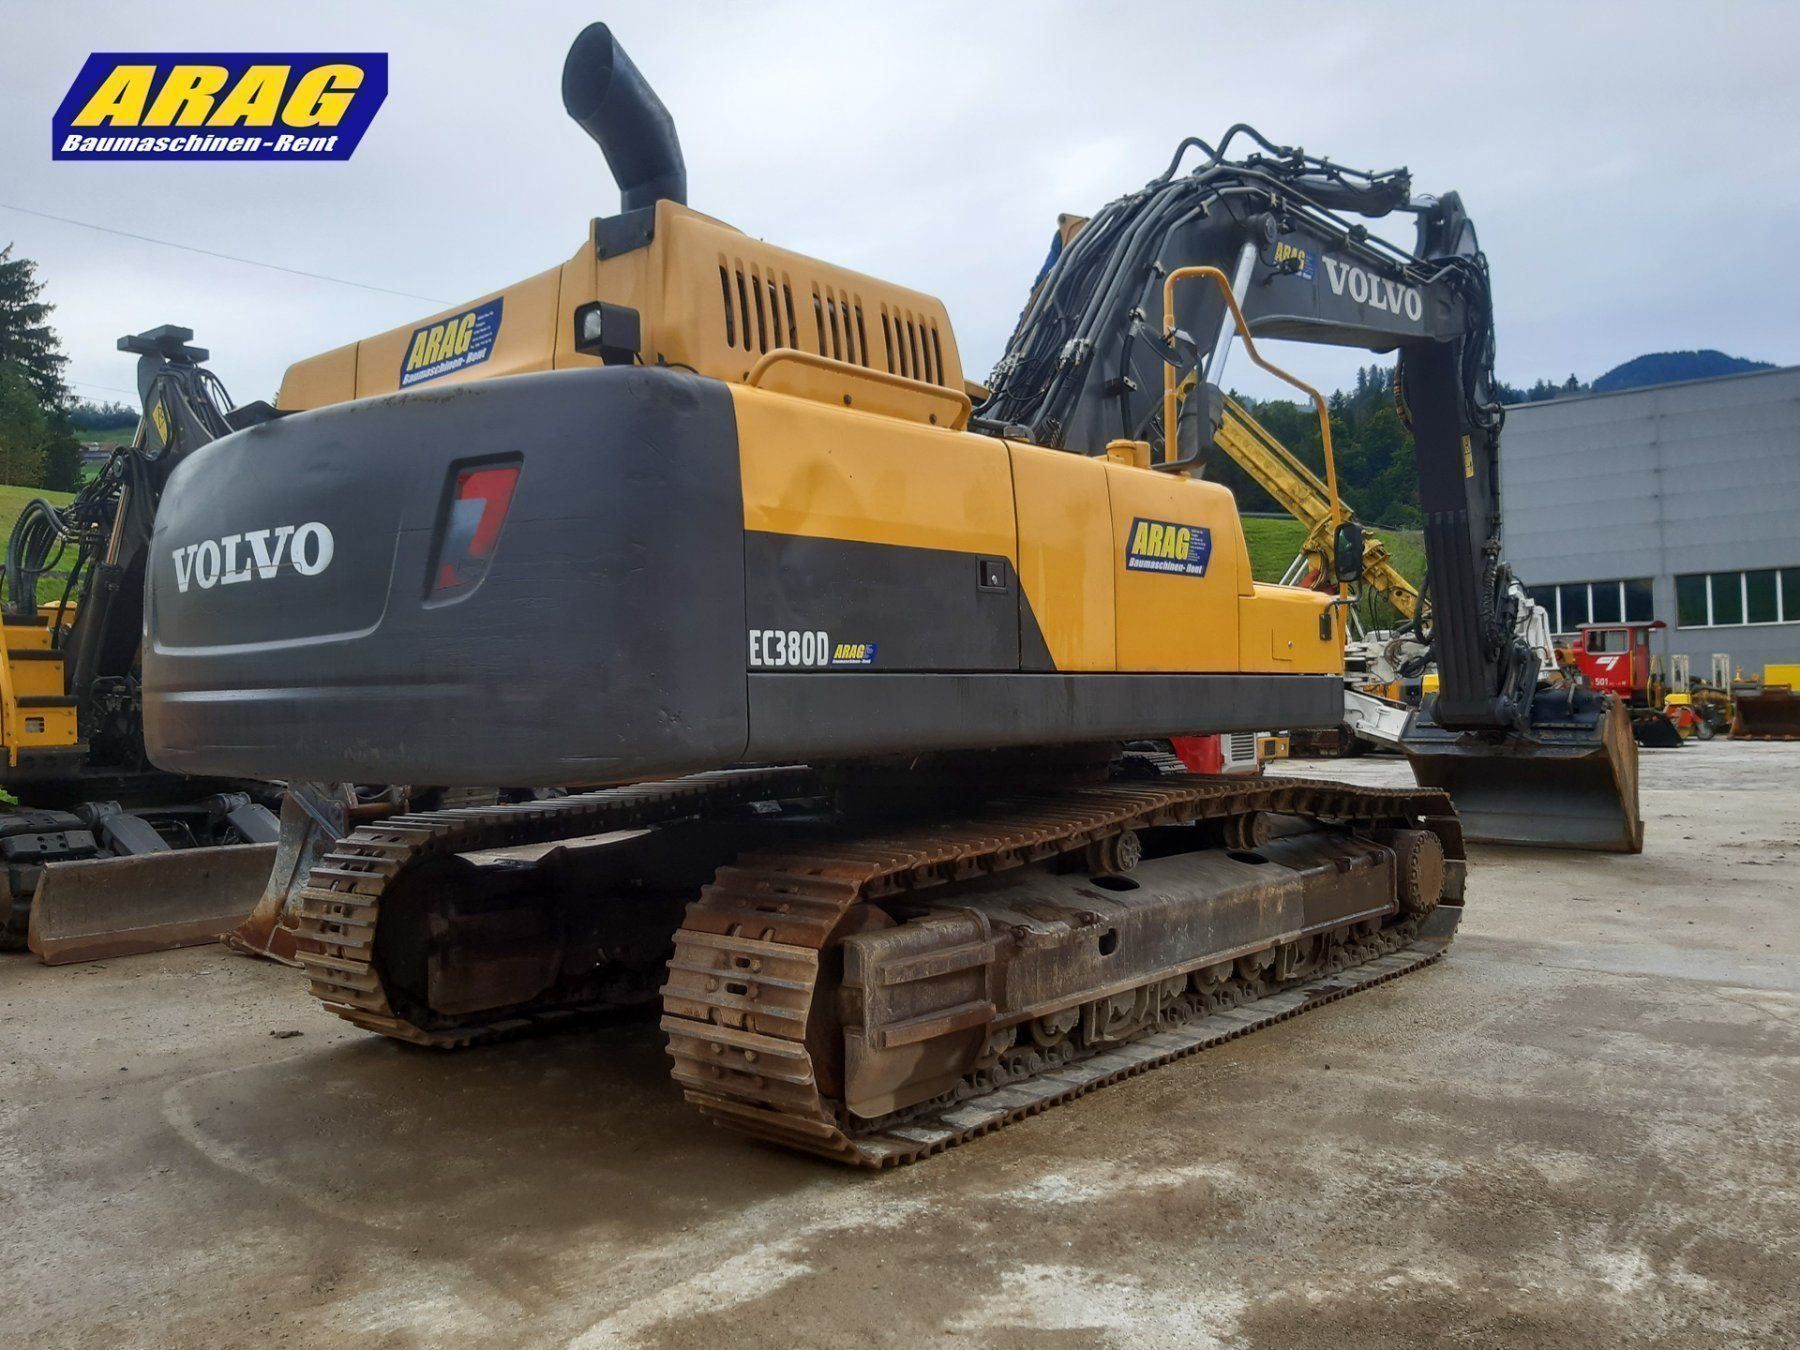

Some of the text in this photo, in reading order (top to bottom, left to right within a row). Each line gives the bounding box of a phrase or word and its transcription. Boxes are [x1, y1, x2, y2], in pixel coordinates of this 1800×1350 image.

[1322, 256, 1422, 322] VOLVO
[407, 313, 476, 371] ARAG
[172, 521, 334, 593] VOLVO
[1131, 521, 1191, 560] ARAG
[749, 629, 829, 666] EC380D
[834, 644, 865, 659] ARAG
